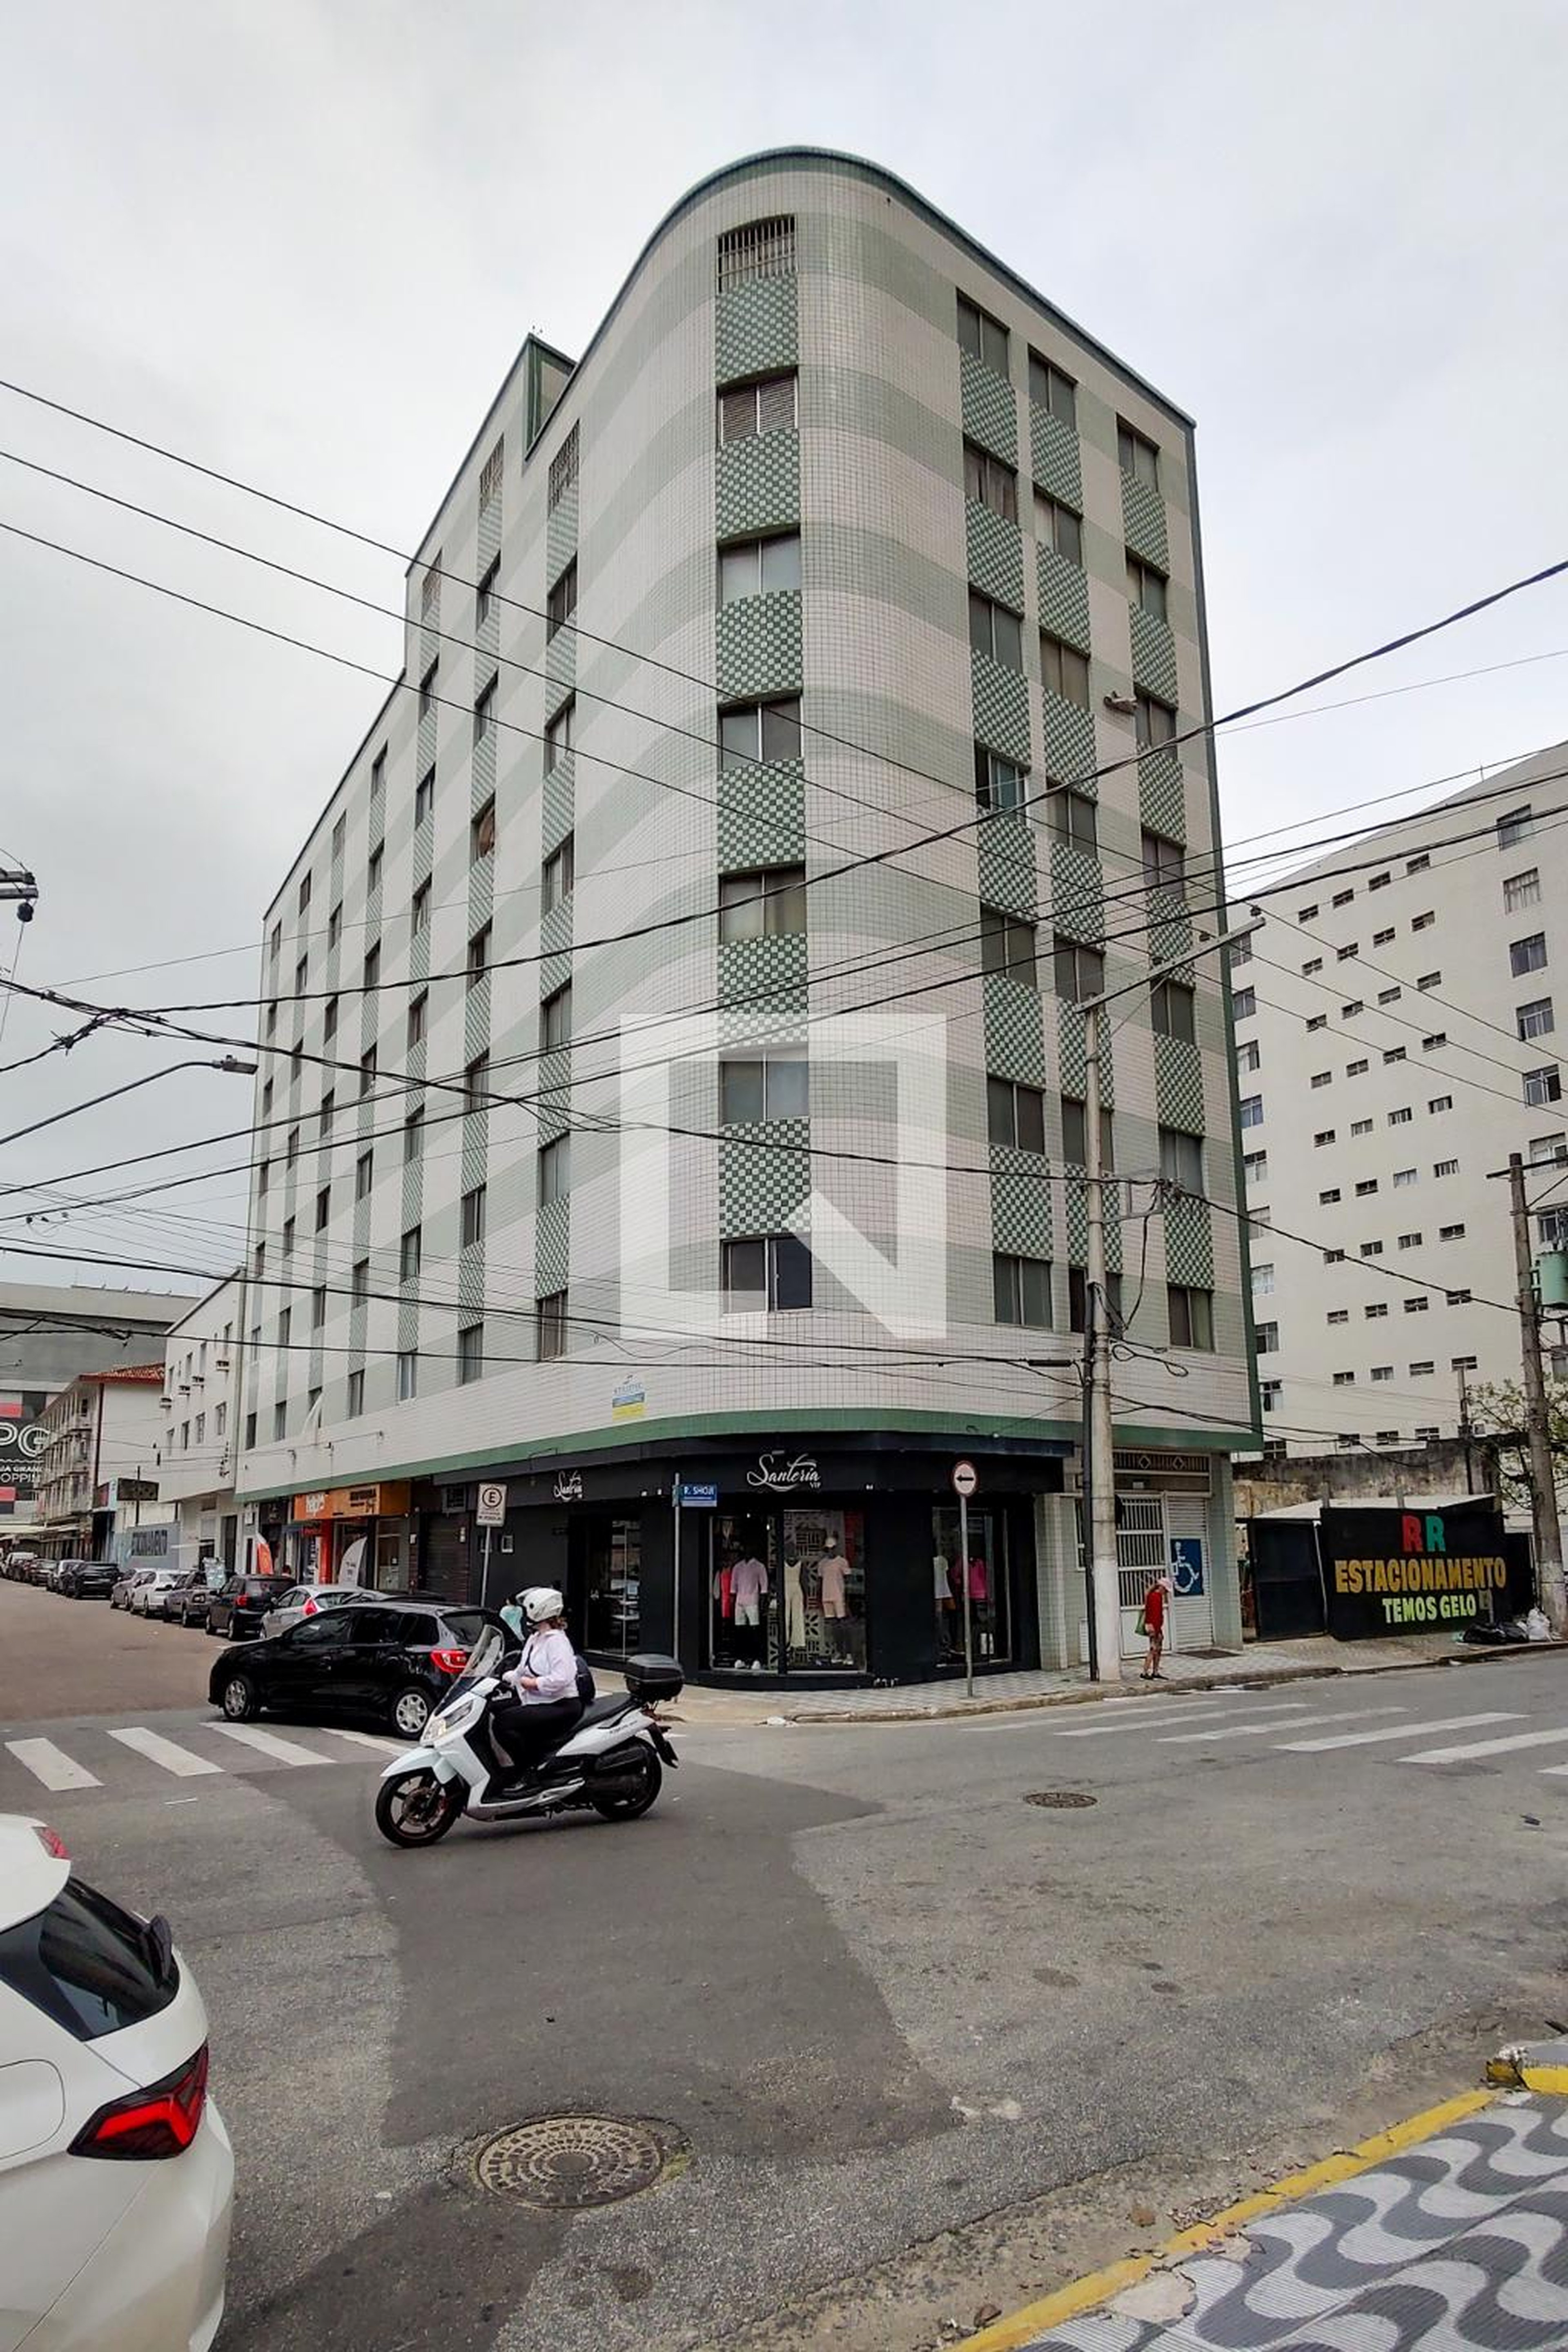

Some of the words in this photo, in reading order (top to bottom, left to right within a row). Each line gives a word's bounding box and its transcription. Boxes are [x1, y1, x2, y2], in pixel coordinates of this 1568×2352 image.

[747, 1453, 821, 1492] Santeria
[489, 1491, 496, 1503] E
[1334, 1557, 1507, 1593] ESTACIONAMENTO
[1382, 1596, 1437, 1624] TEMOS
[1440, 1593, 1477, 1619] GELO
